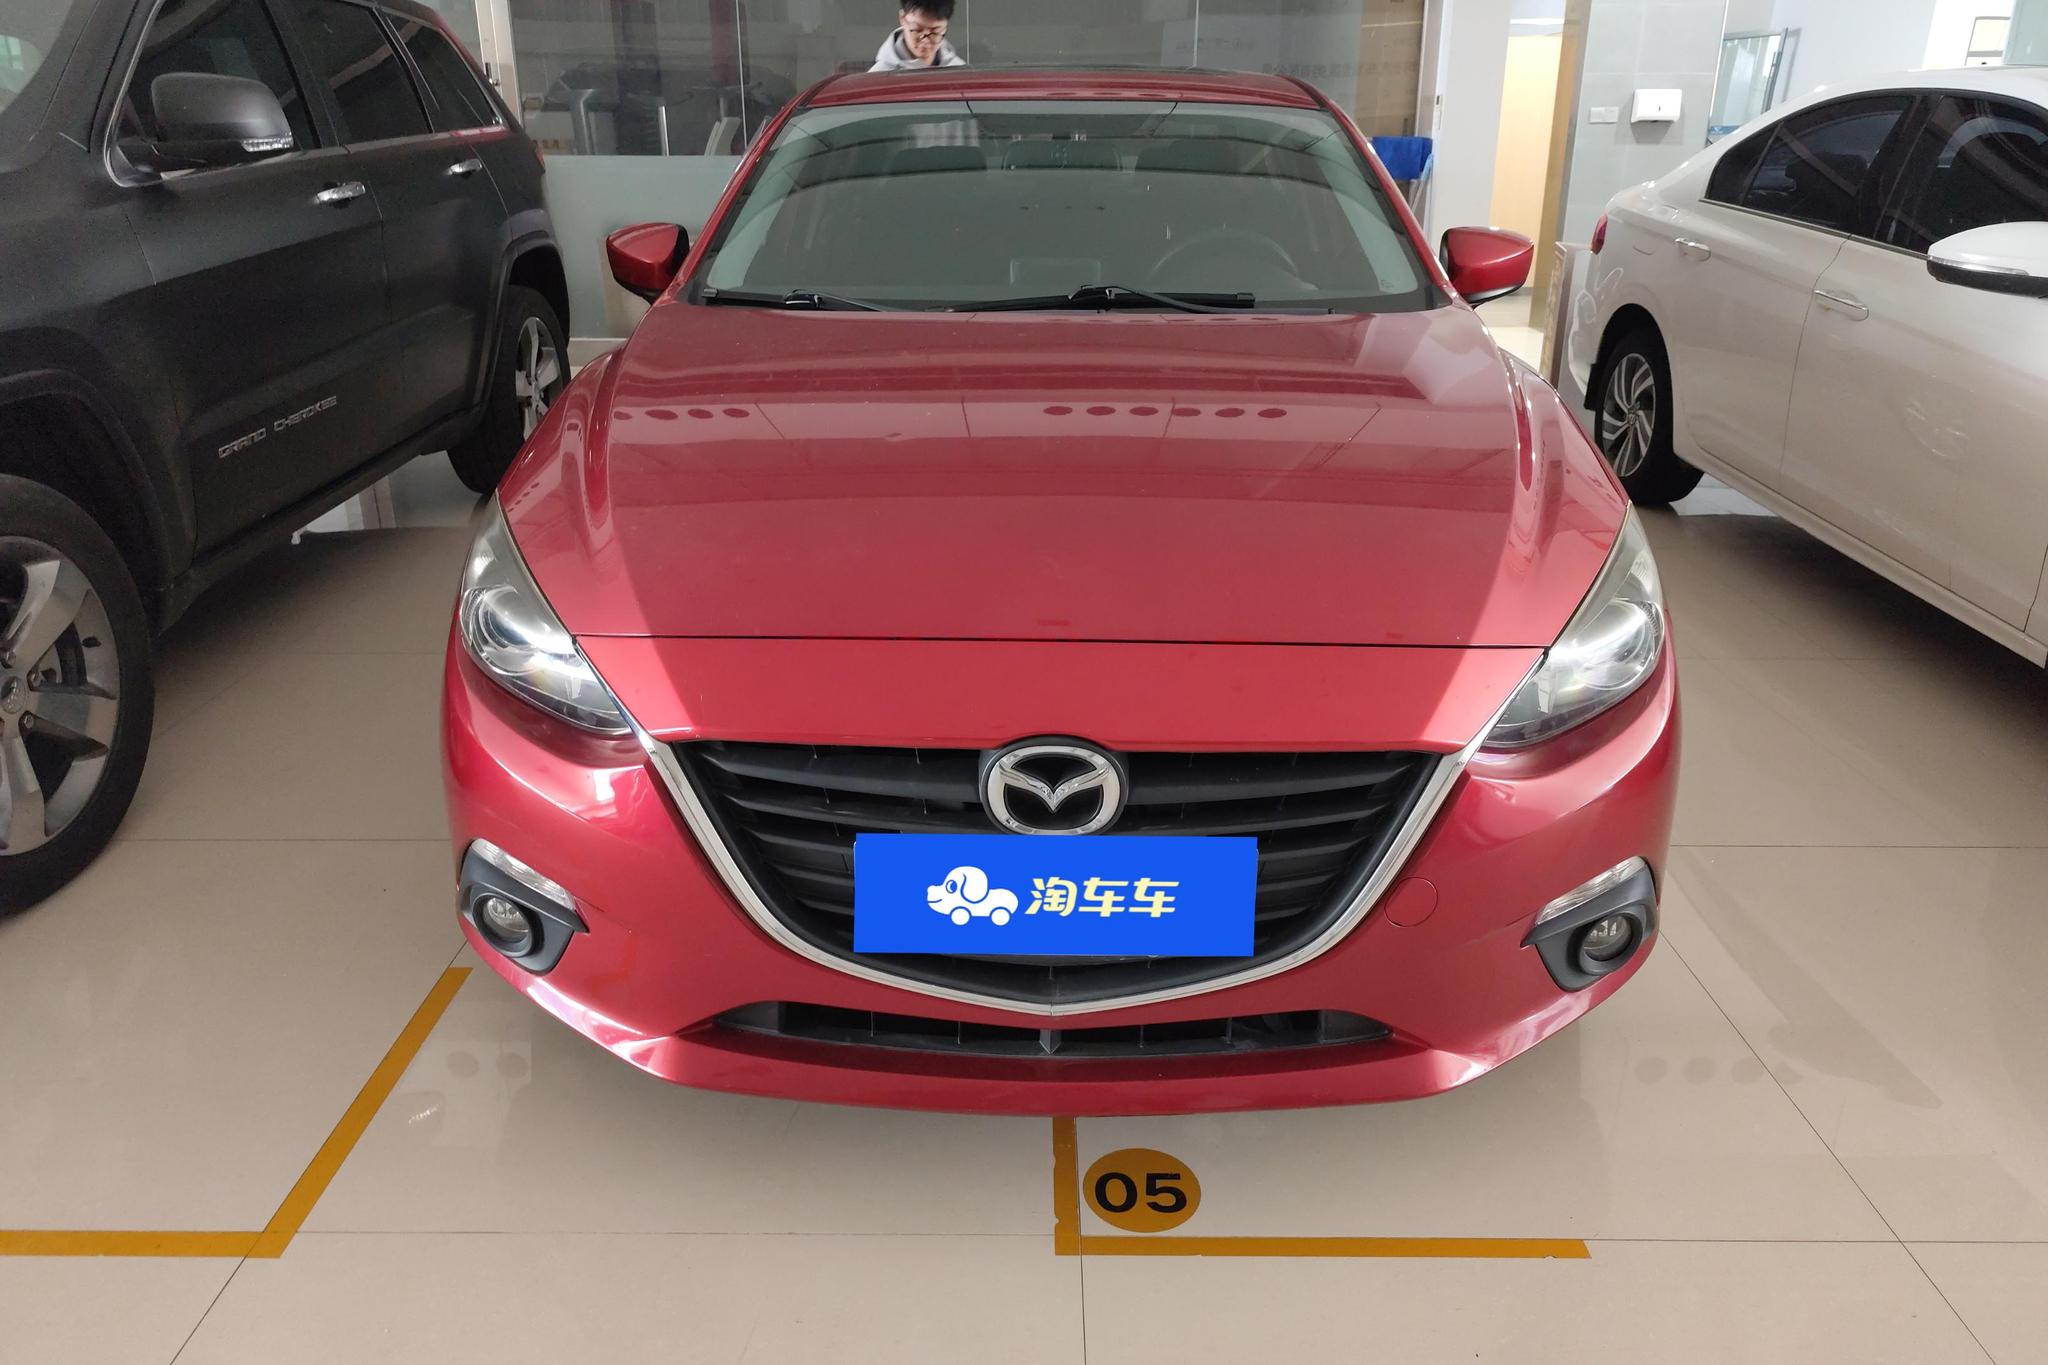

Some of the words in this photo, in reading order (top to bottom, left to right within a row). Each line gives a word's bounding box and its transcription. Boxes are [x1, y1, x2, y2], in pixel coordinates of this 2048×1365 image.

[218, 427, 267, 459] GRAND
[273, 395, 337, 432] CHEROKEE
[1095, 1172, 1187, 1213] 05
